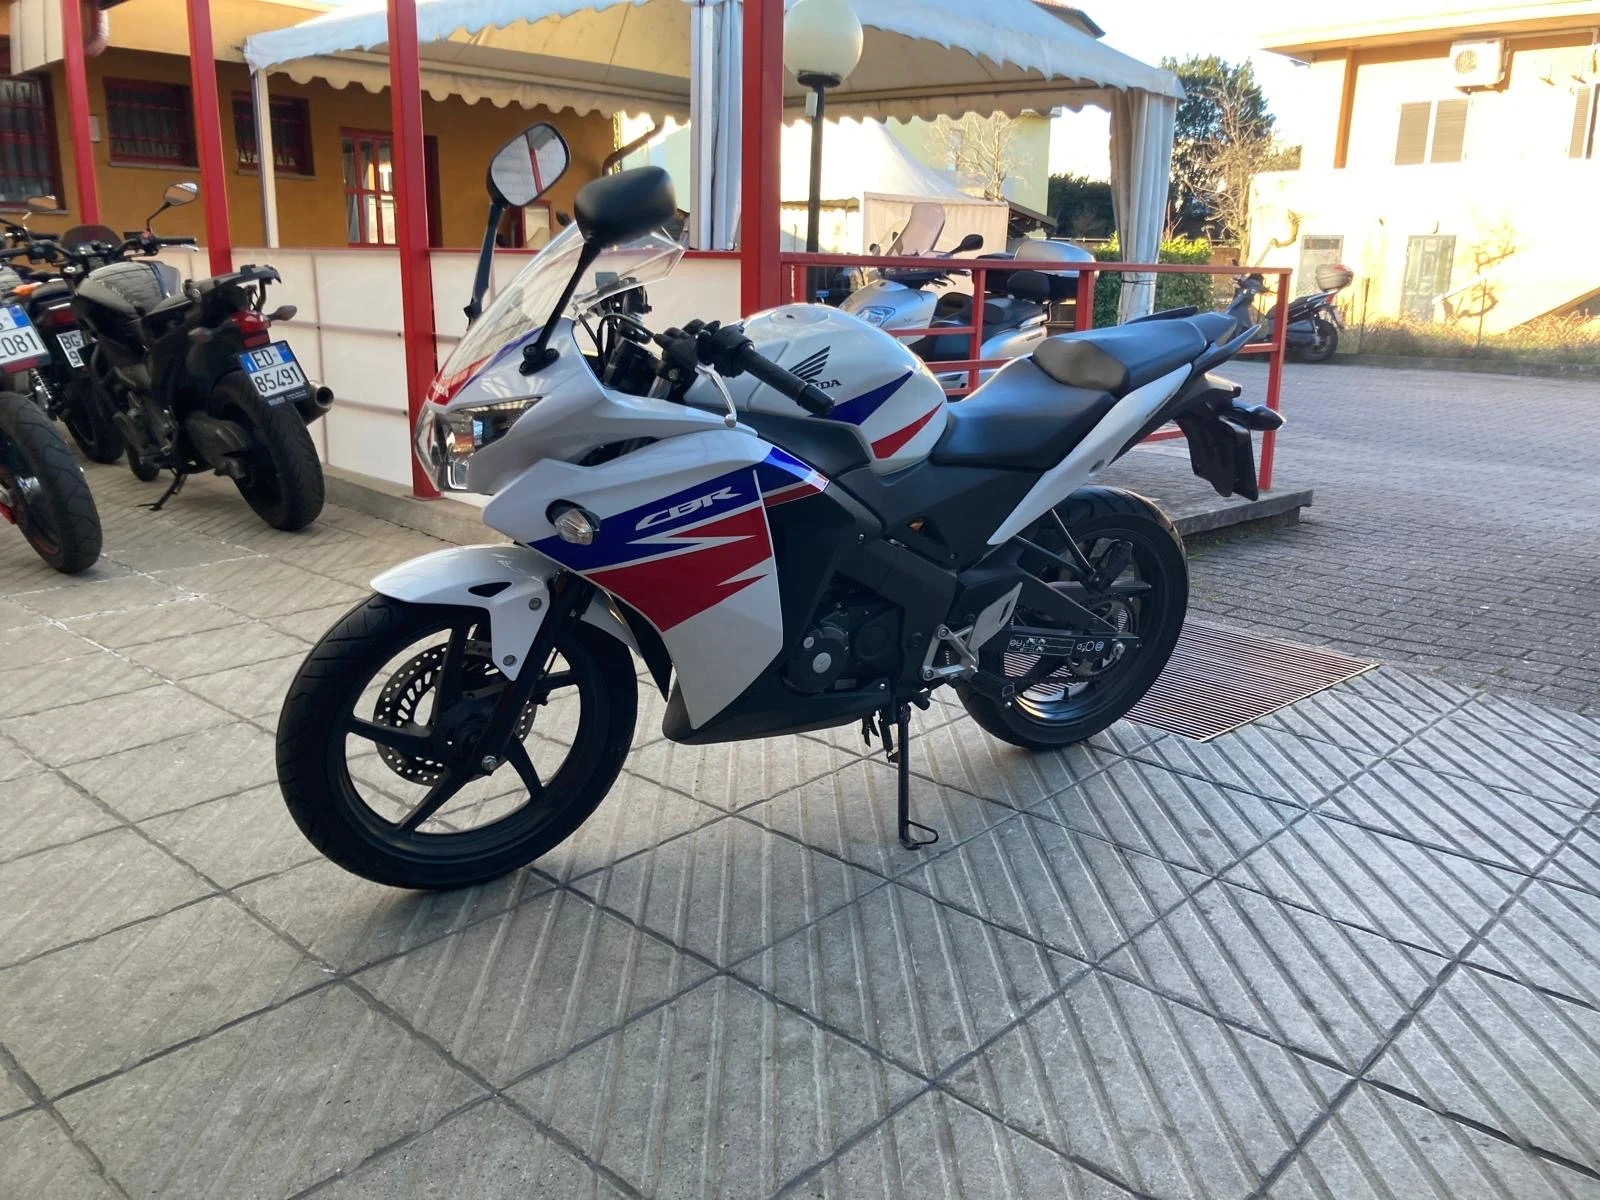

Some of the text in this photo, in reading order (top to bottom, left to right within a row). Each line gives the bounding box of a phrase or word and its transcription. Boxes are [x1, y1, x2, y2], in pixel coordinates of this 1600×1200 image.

[0, 332, 38, 358] 081
[252, 349, 274, 368] ED
[254, 366, 301, 393] 85491
[635, 486, 742, 531] CBR
